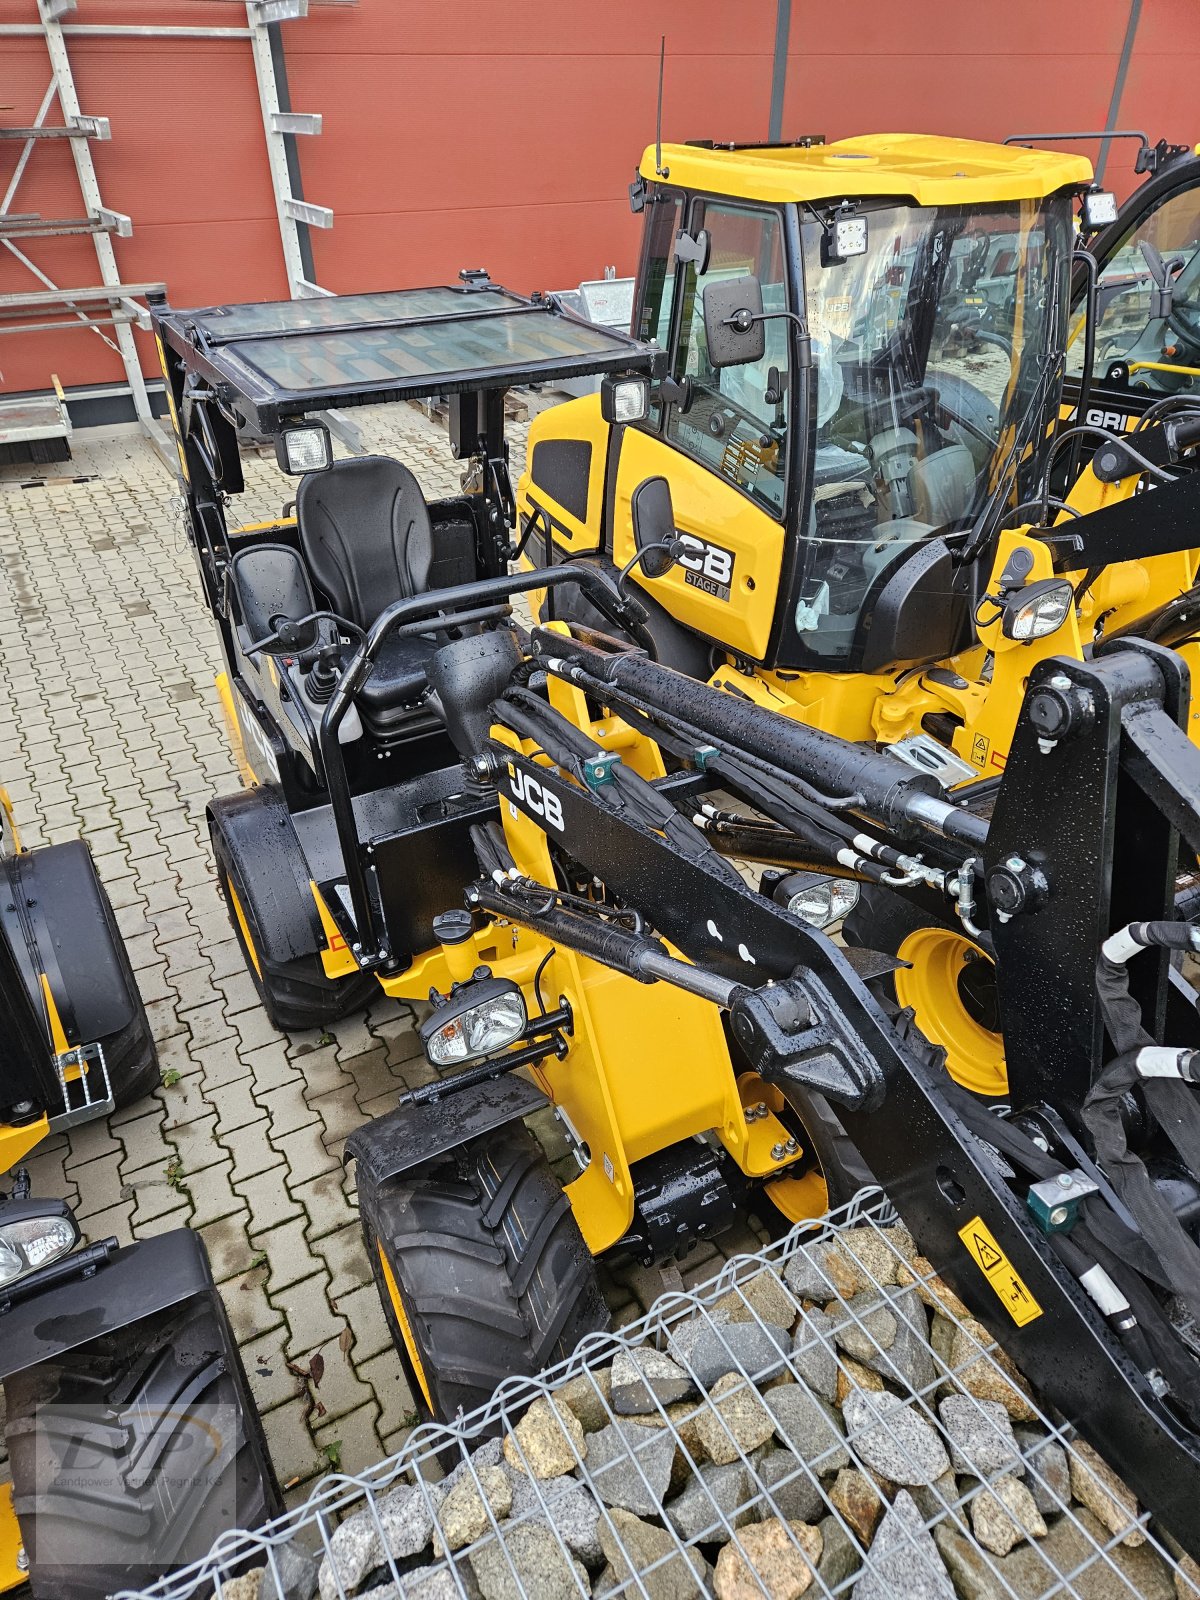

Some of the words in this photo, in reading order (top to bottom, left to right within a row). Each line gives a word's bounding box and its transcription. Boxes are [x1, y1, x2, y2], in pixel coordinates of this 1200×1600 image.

[675, 530, 732, 584] CB
[686, 572, 718, 596] STAGE
[241, 700, 282, 784] JCB
[510, 767, 565, 832] JCB
